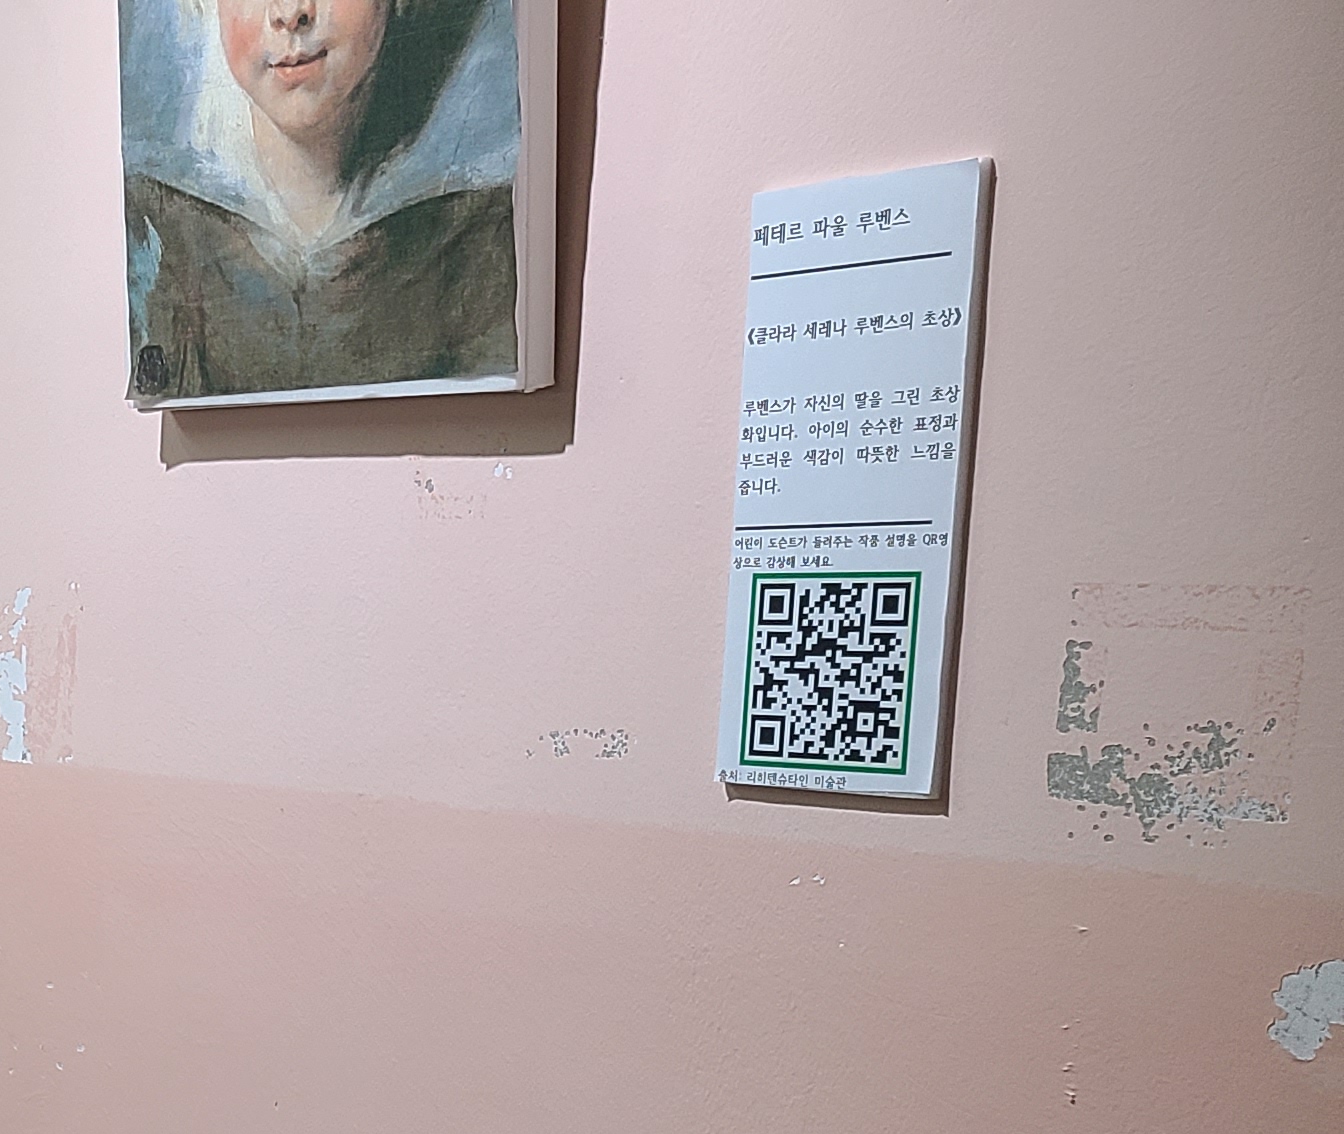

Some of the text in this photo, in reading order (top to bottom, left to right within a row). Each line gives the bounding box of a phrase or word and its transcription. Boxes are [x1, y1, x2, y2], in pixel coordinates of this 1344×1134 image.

[752, 208, 911, 246] 페테르 파울 루벤스
[803, 319, 847, 339] 세레나
[853, 311, 914, 335] 루벤스의
[743, 384, 960, 416] 루벤스가 자신의 딸을 그린 초상
[741, 413, 958, 443] 화입니다. 아이의 순수한 표정과
[740, 441, 956, 470] 부드러운 색감이 따뜻한 느낌을
[738, 477, 781, 496] 줍니다.
[735, 532, 949, 550] 어린이 도슨트가 들려주는 작품 설명을 QR영
[733, 556, 761, 569] 상으로
[766, 556, 796, 569] 감상해
[718, 768, 847, 789] 출처: 리히텐슈타인 미술관
